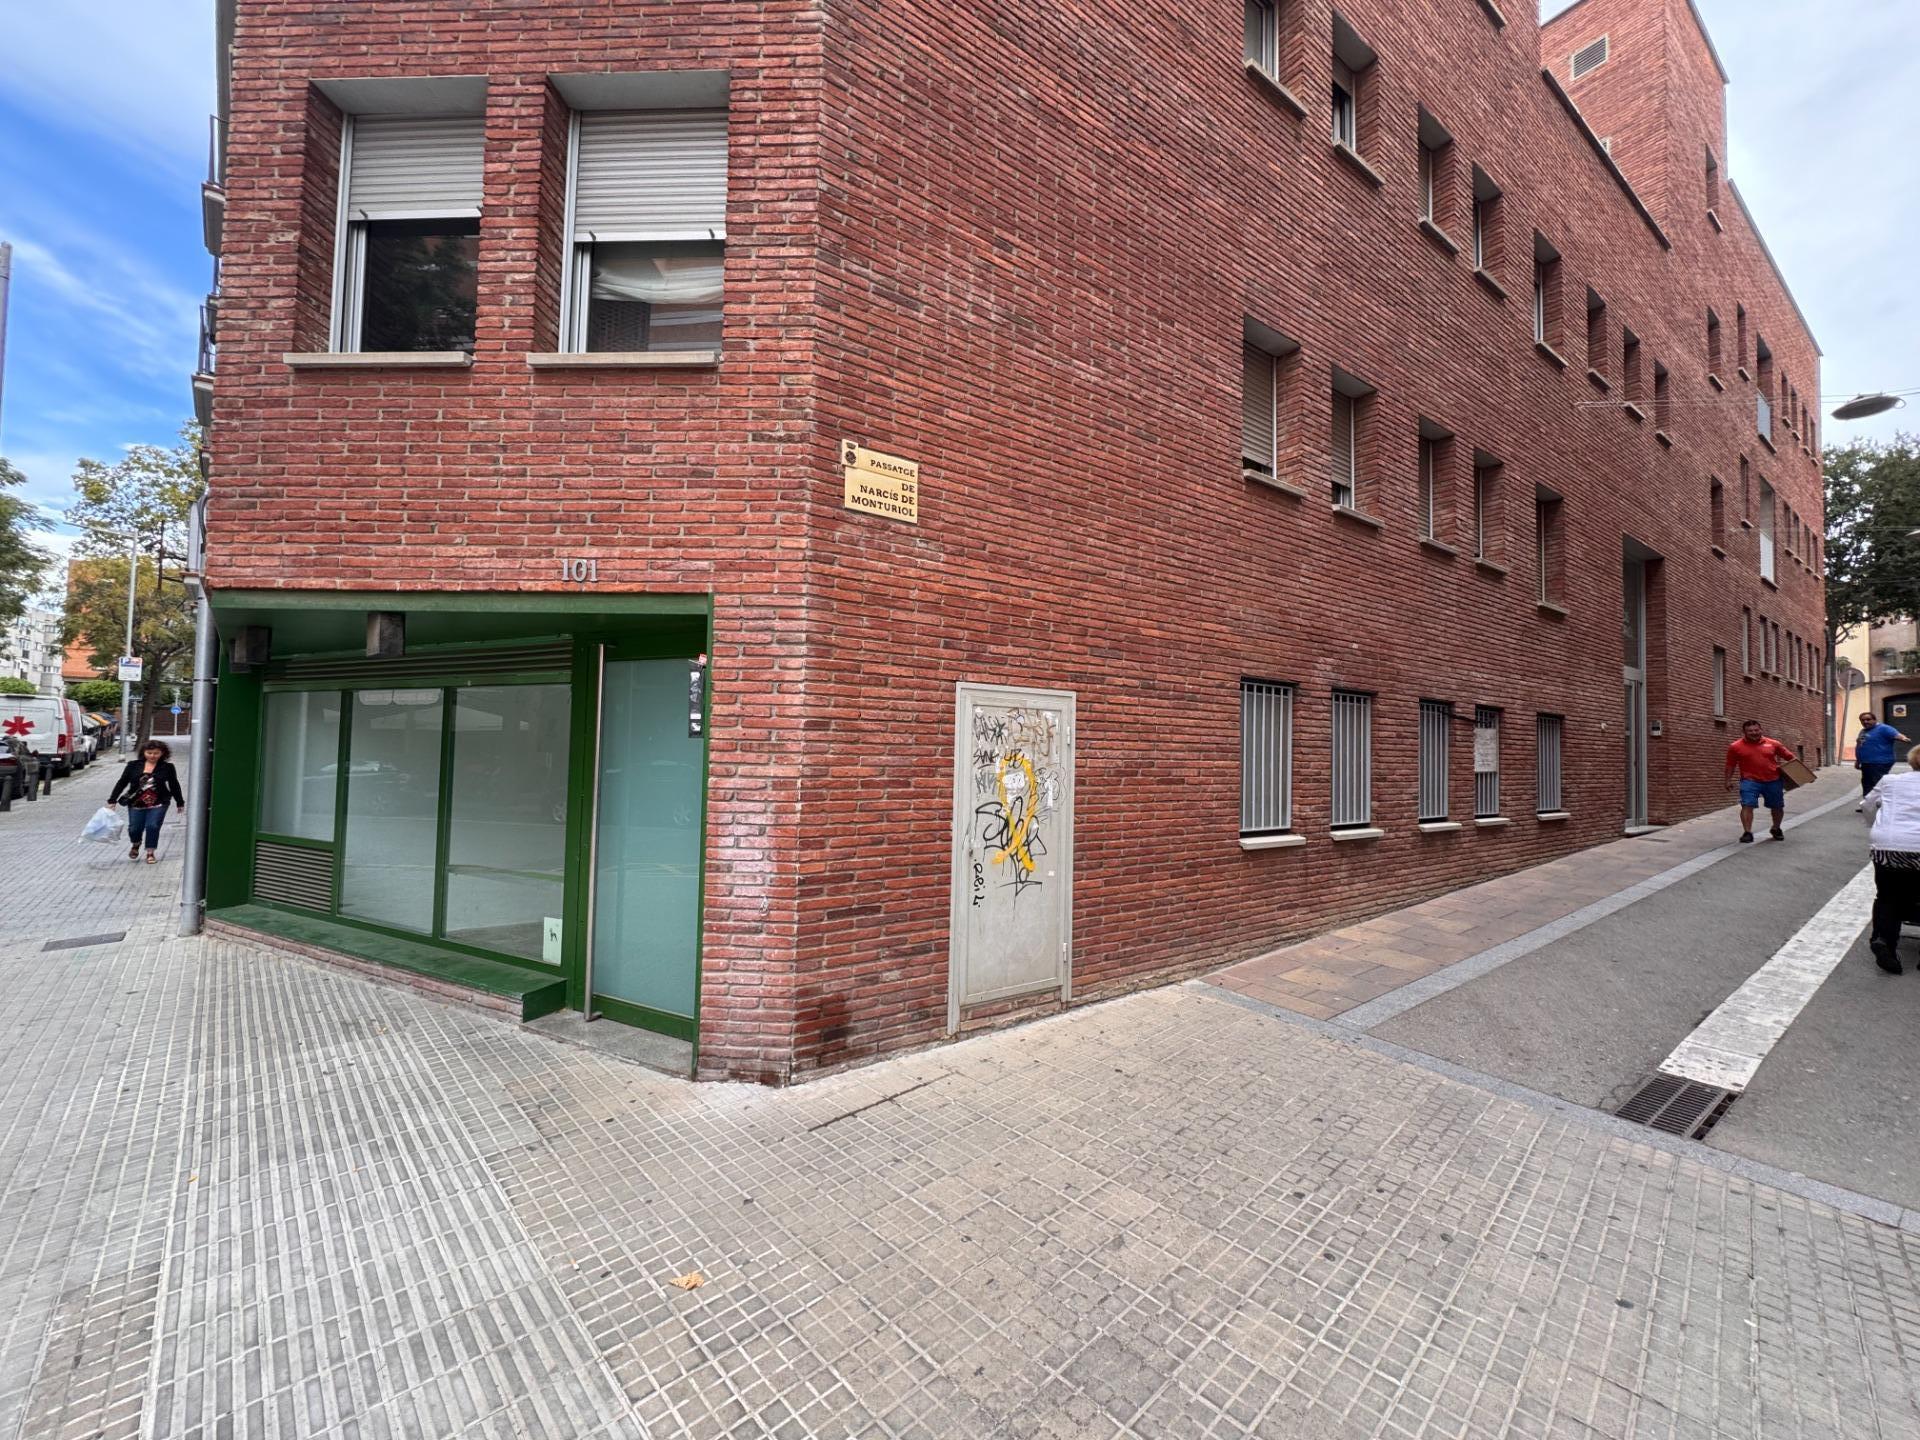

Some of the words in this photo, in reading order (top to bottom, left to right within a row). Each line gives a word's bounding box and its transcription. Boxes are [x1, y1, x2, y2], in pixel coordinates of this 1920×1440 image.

[870, 459, 915, 477] PASSATGE
[901, 483, 915, 493] DE
[851, 495, 915, 517] MONTURIOL
[901, 495, 915, 505] DE
[561, 558, 598, 582] 101
